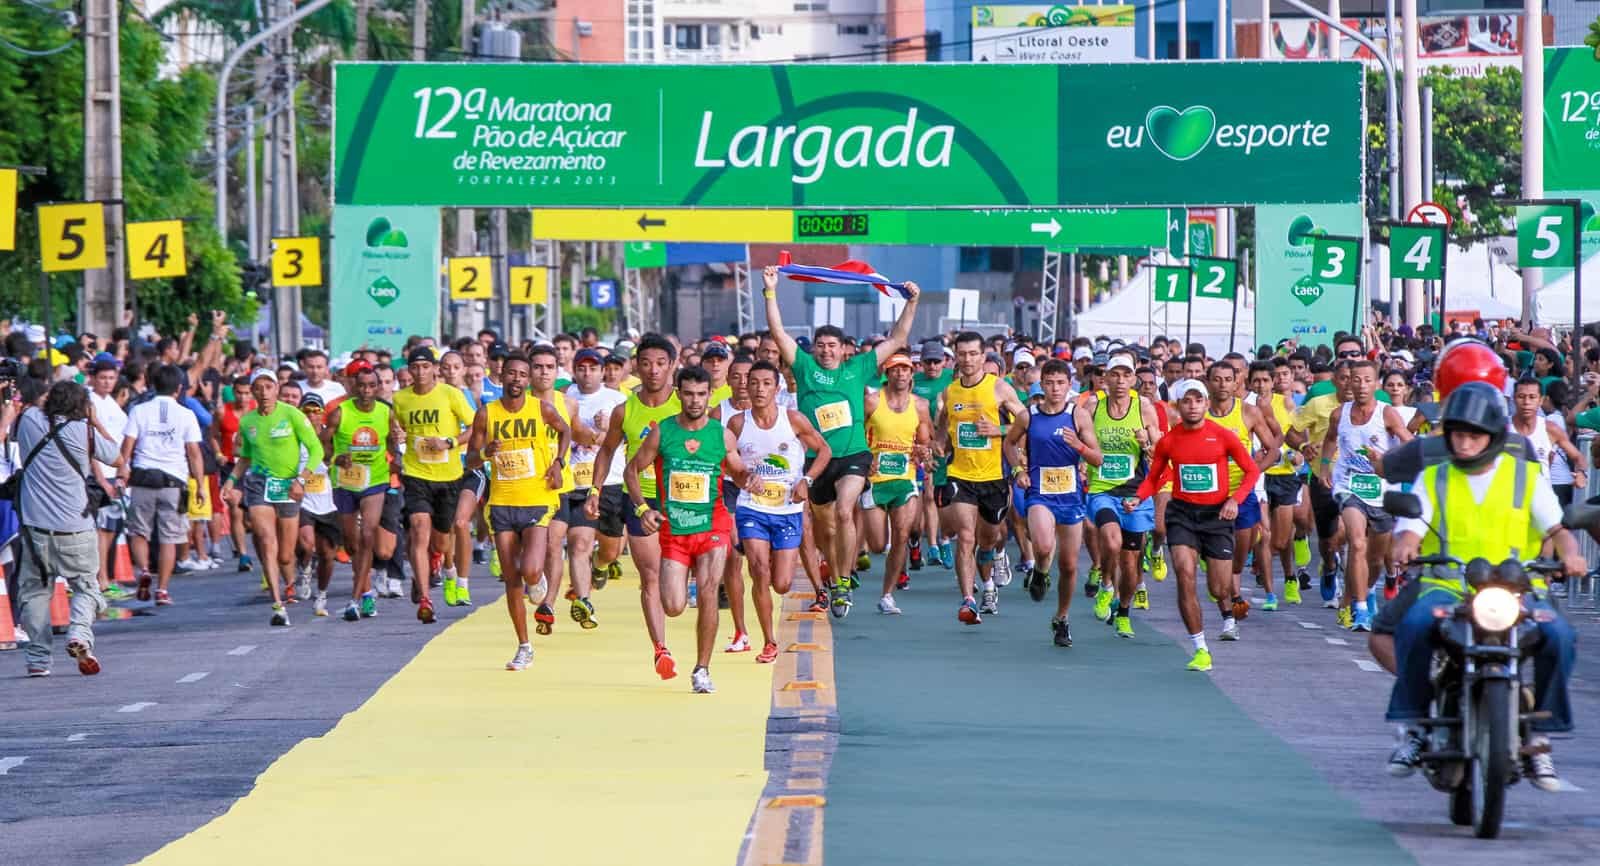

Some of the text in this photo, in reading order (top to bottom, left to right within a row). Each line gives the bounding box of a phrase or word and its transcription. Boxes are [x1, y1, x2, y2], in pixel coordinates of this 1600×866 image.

[1018, 35, 1109, 48] Litoral Oeste
[1019, 51, 1081, 61] West Coast
[488, 97, 611, 121] Maratona
[473, 124, 626, 152] Pão de Açúcar
[694, 107, 955, 184] Largada
[1106, 120, 1330, 155] eu esporte
[1585, 128, 1599, 139] de
[453, 151, 606, 170] de Revezamento
[459, 175, 617, 185] FORTALEZA 2013
[57, 218, 86, 261] 5
[1531, 216, 1562, 259] 5
[144, 234, 170, 268] 4
[1320, 246, 1345, 279] 3
[1403, 236, 1432, 272] 4
[282, 249, 303, 279] 3
[460, 267, 478, 293] 2
[523, 276, 533, 298] 1
[1167, 273, 1179, 298] 1
[1202, 266, 1226, 294] 2
[1295, 286, 1320, 296] taeq
[598, 285, 610, 304] 5
[408, 409, 440, 425] KM
[493, 418, 537, 440] KM
